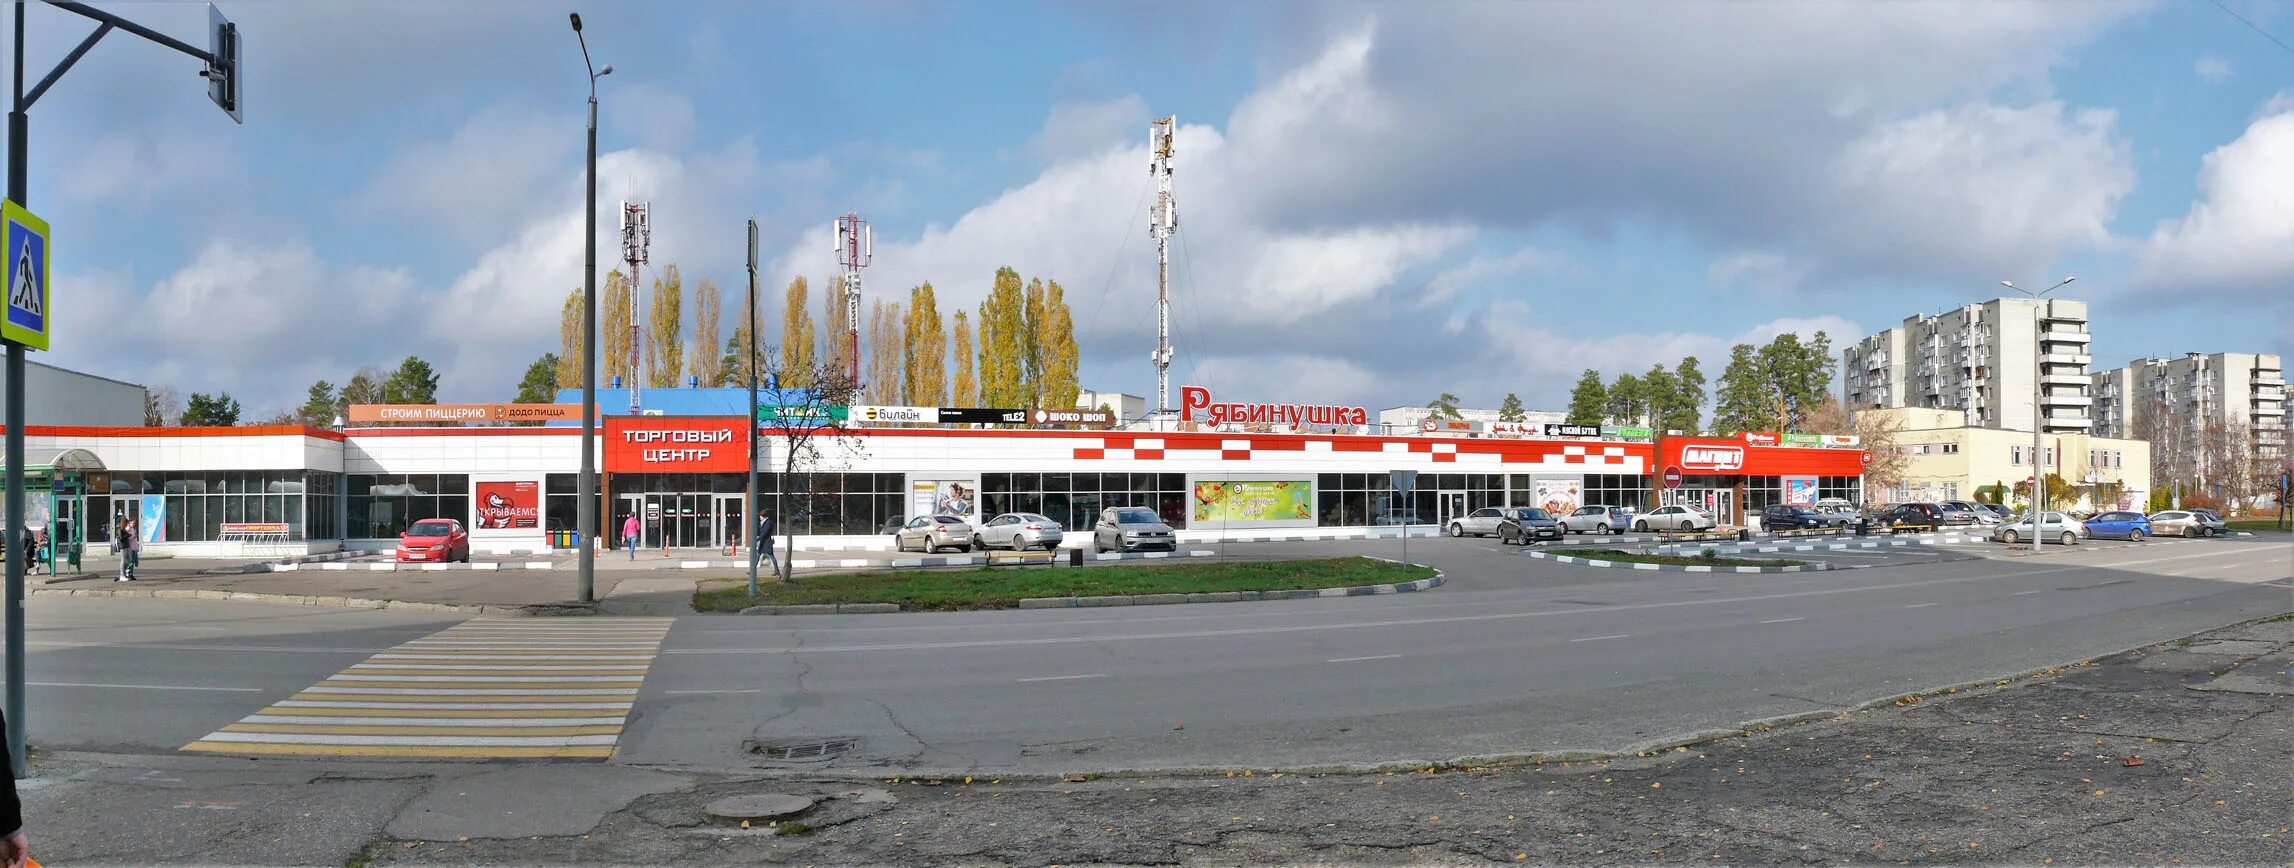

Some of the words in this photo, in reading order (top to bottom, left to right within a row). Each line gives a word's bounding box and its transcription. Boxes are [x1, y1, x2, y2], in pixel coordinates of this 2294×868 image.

[380, 407, 422, 419] СТРОИМ
[425, 408, 486, 420] ПИЦЦЕРИЮ
[879, 409, 921, 420] билайн
[1180, 386, 1367, 431] Рябинушка
[1003, 412, 1025, 421] TELE2
[622, 428, 733, 443] ТОРГОВЫЙ
[643, 449, 711, 463] ЦЕНТР
[1686, 450, 1741, 464] МАГНИТ
